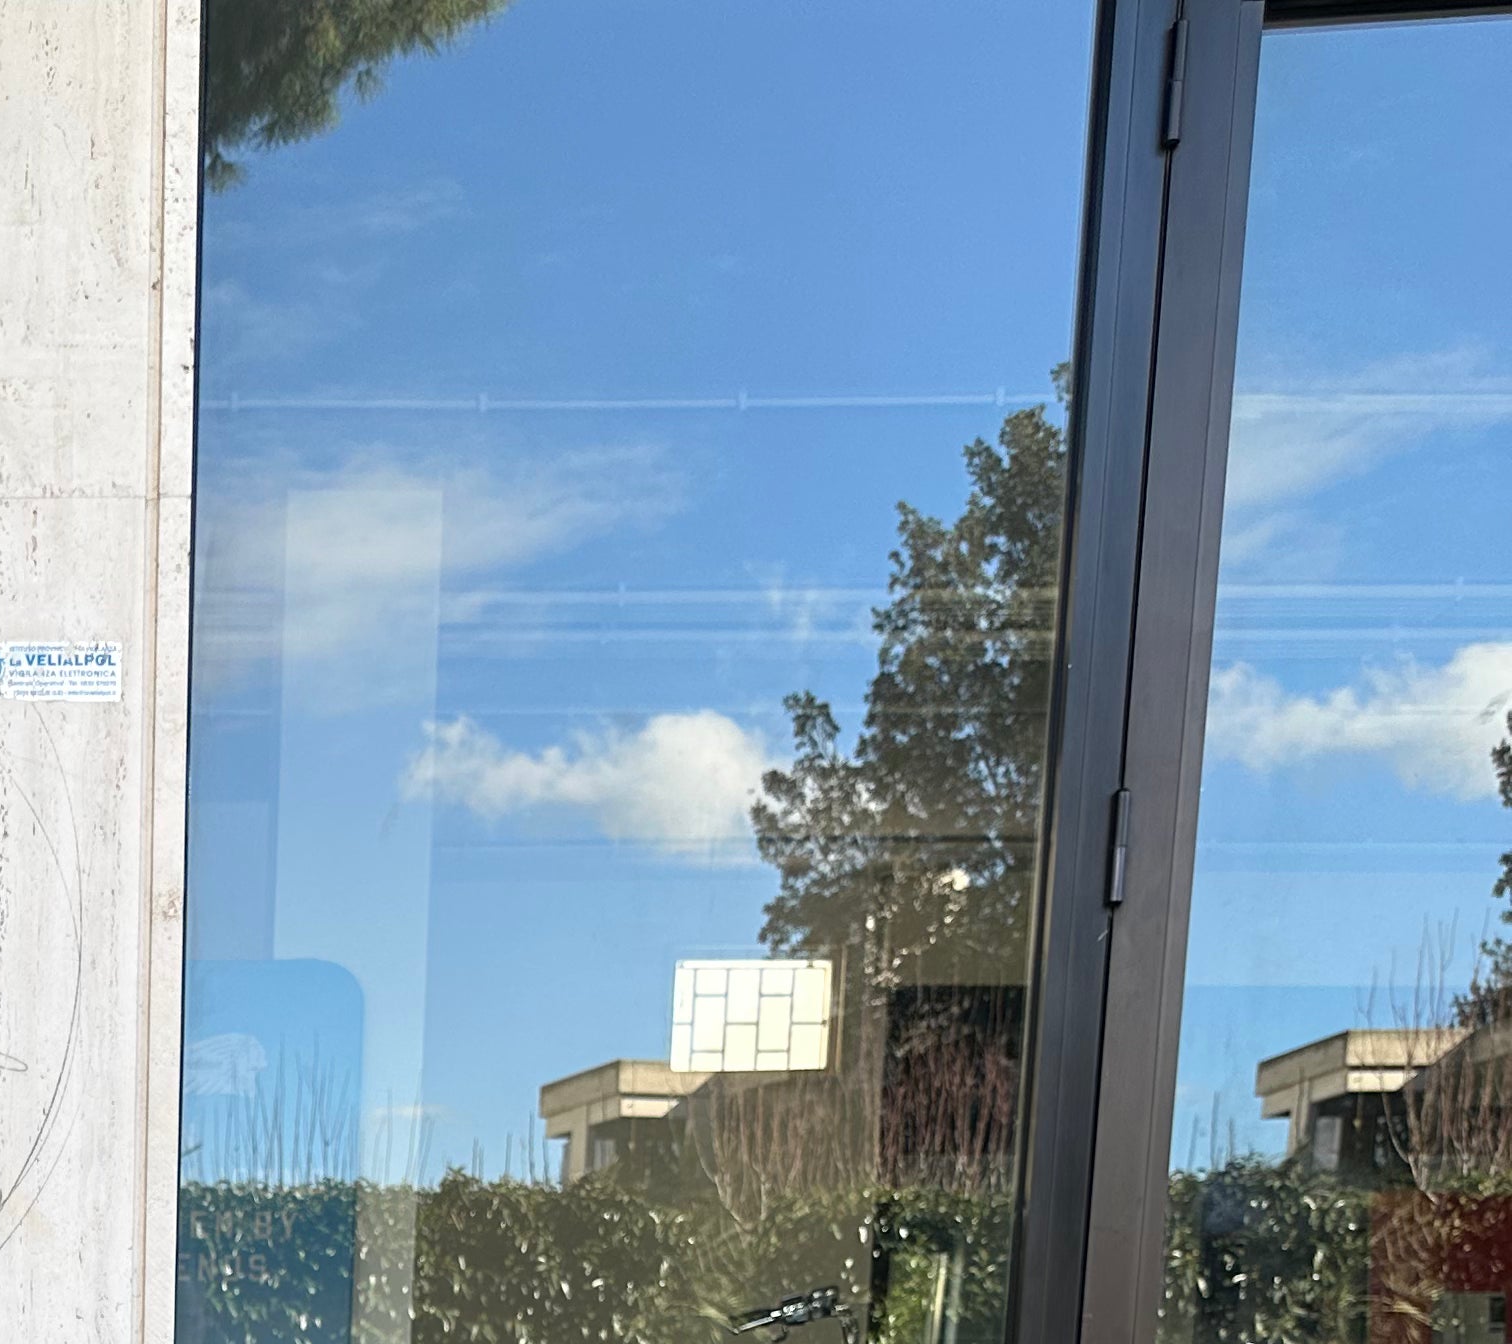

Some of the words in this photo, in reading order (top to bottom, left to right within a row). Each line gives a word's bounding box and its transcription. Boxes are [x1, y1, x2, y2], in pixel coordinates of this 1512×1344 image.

[9, 658, 22, 667] La
[25, 654, 117, 667] VELIALPOL
[59, 670, 117, 678] ELETTRONICA
